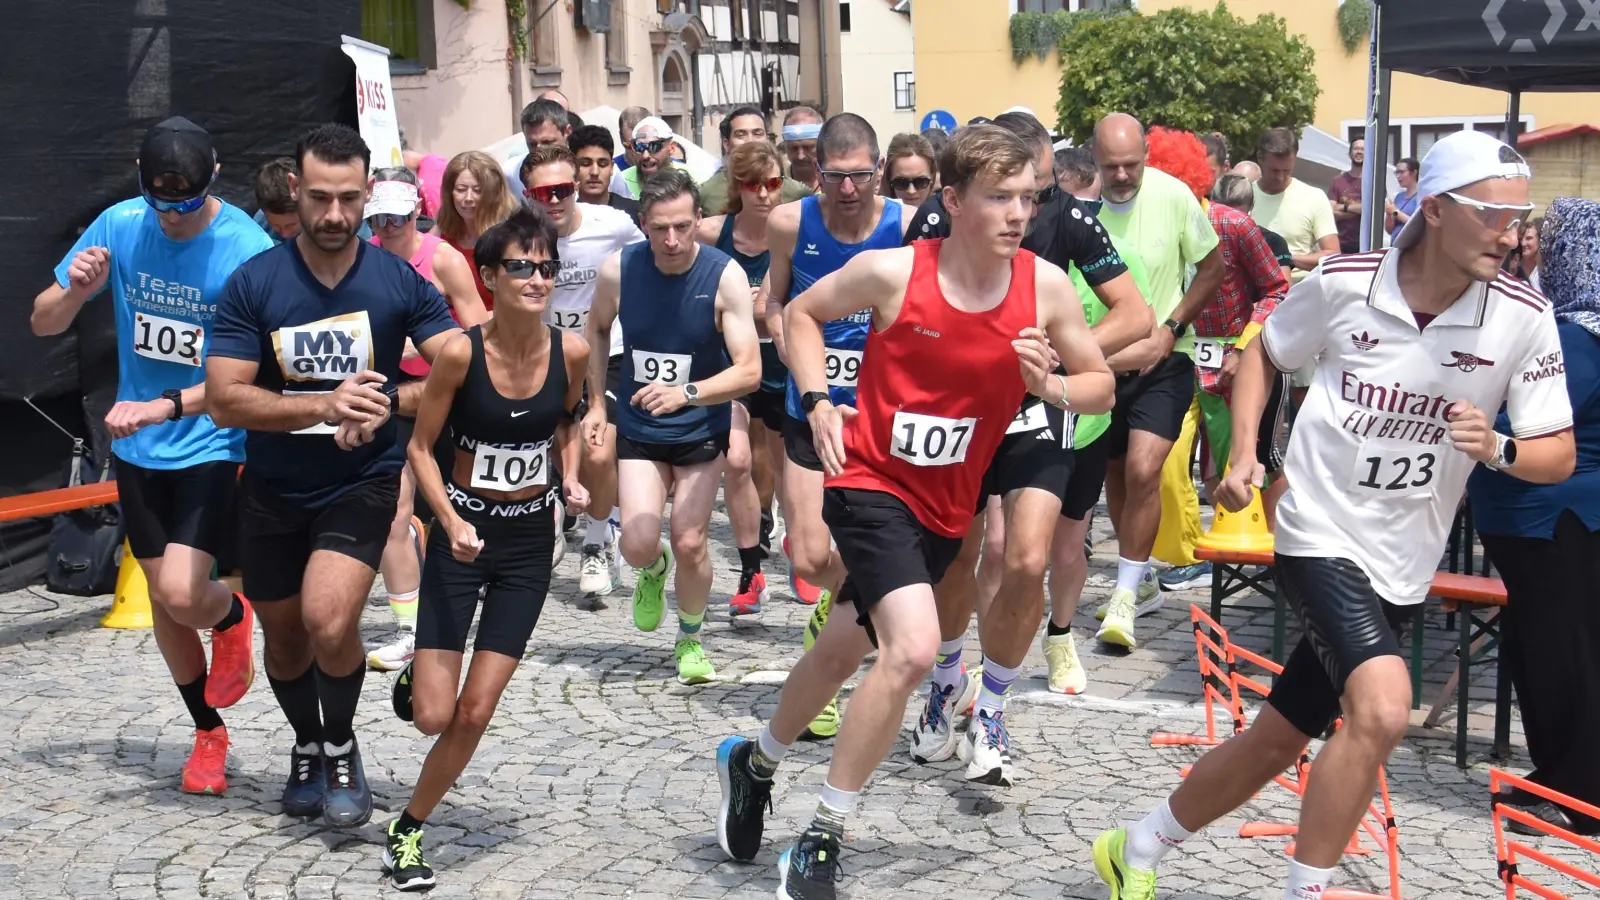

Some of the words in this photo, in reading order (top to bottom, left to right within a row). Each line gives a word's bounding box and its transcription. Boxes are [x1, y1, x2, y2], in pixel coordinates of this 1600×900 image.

[142, 291, 217, 313] VIRNSBERG
[137, 322, 198, 359] 103
[294, 330, 355, 357] MY
[293, 356, 358, 374] GYM
[644, 357, 678, 383] 93
[826, 354, 861, 382] 99
[897, 422, 970, 459] 107
[1342, 410, 1379, 437] FLY
[1376, 418, 1447, 445] BETTER
[479, 453, 543, 486] 109
[1358, 452, 1436, 491] 123
[490, 497, 544, 517] NIKE
